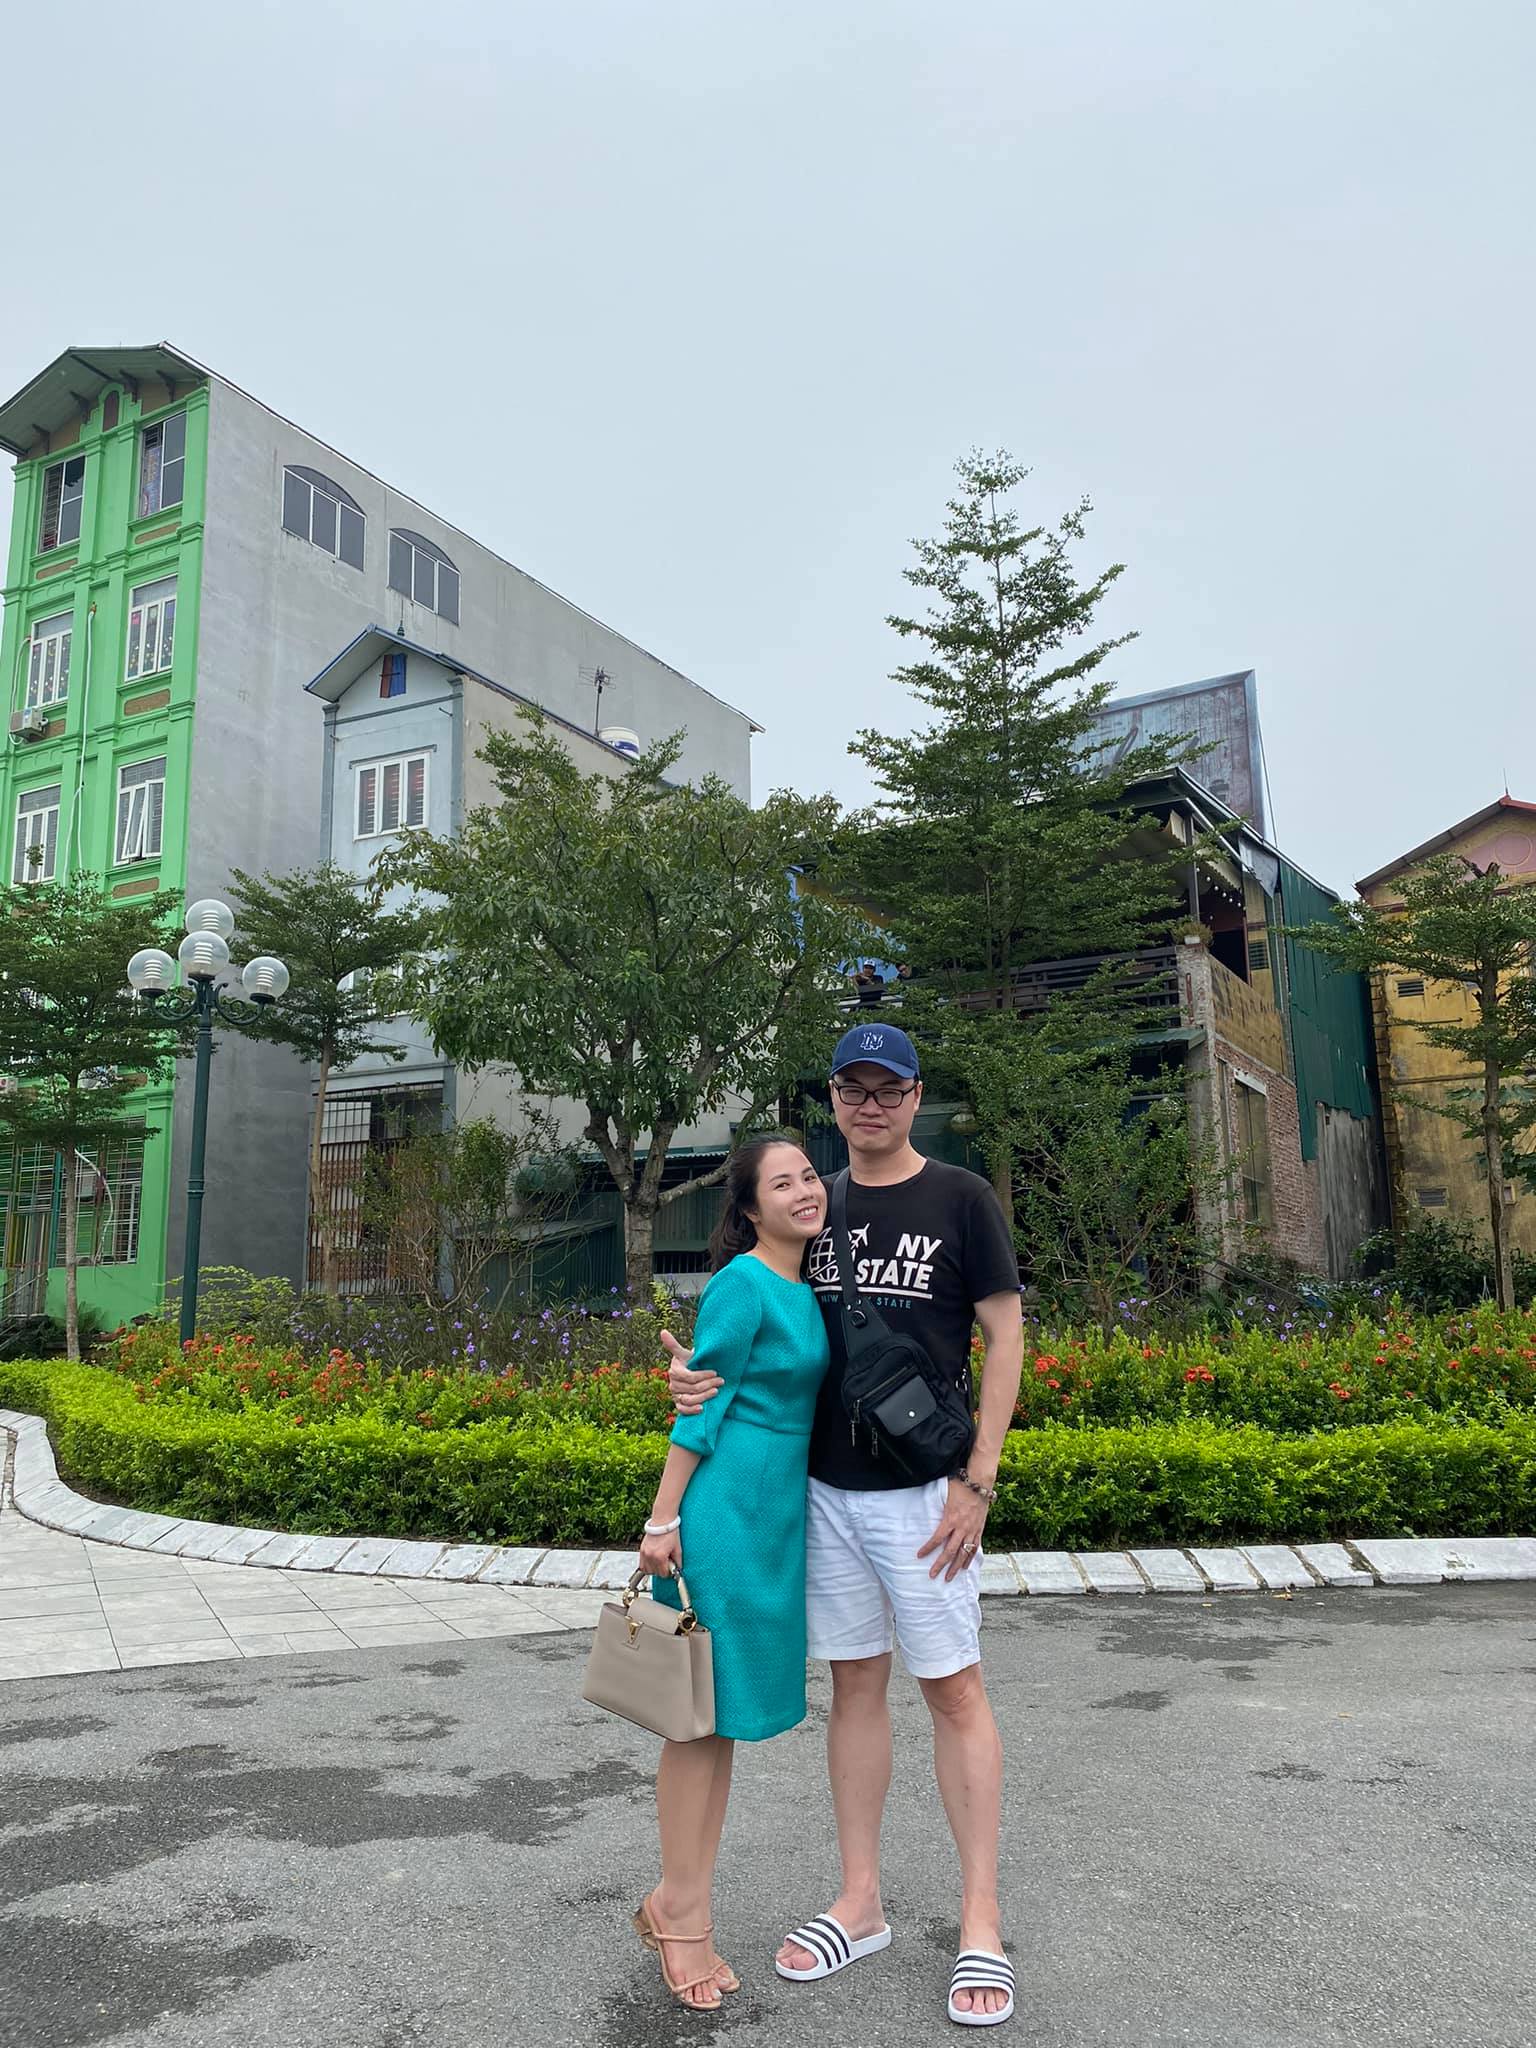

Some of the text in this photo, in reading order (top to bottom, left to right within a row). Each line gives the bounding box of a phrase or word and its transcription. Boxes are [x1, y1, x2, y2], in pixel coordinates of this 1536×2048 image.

[895, 1233, 943, 1262] NY
[855, 1258, 934, 1291] STATE
[876, 1296, 912, 1309] STATE
